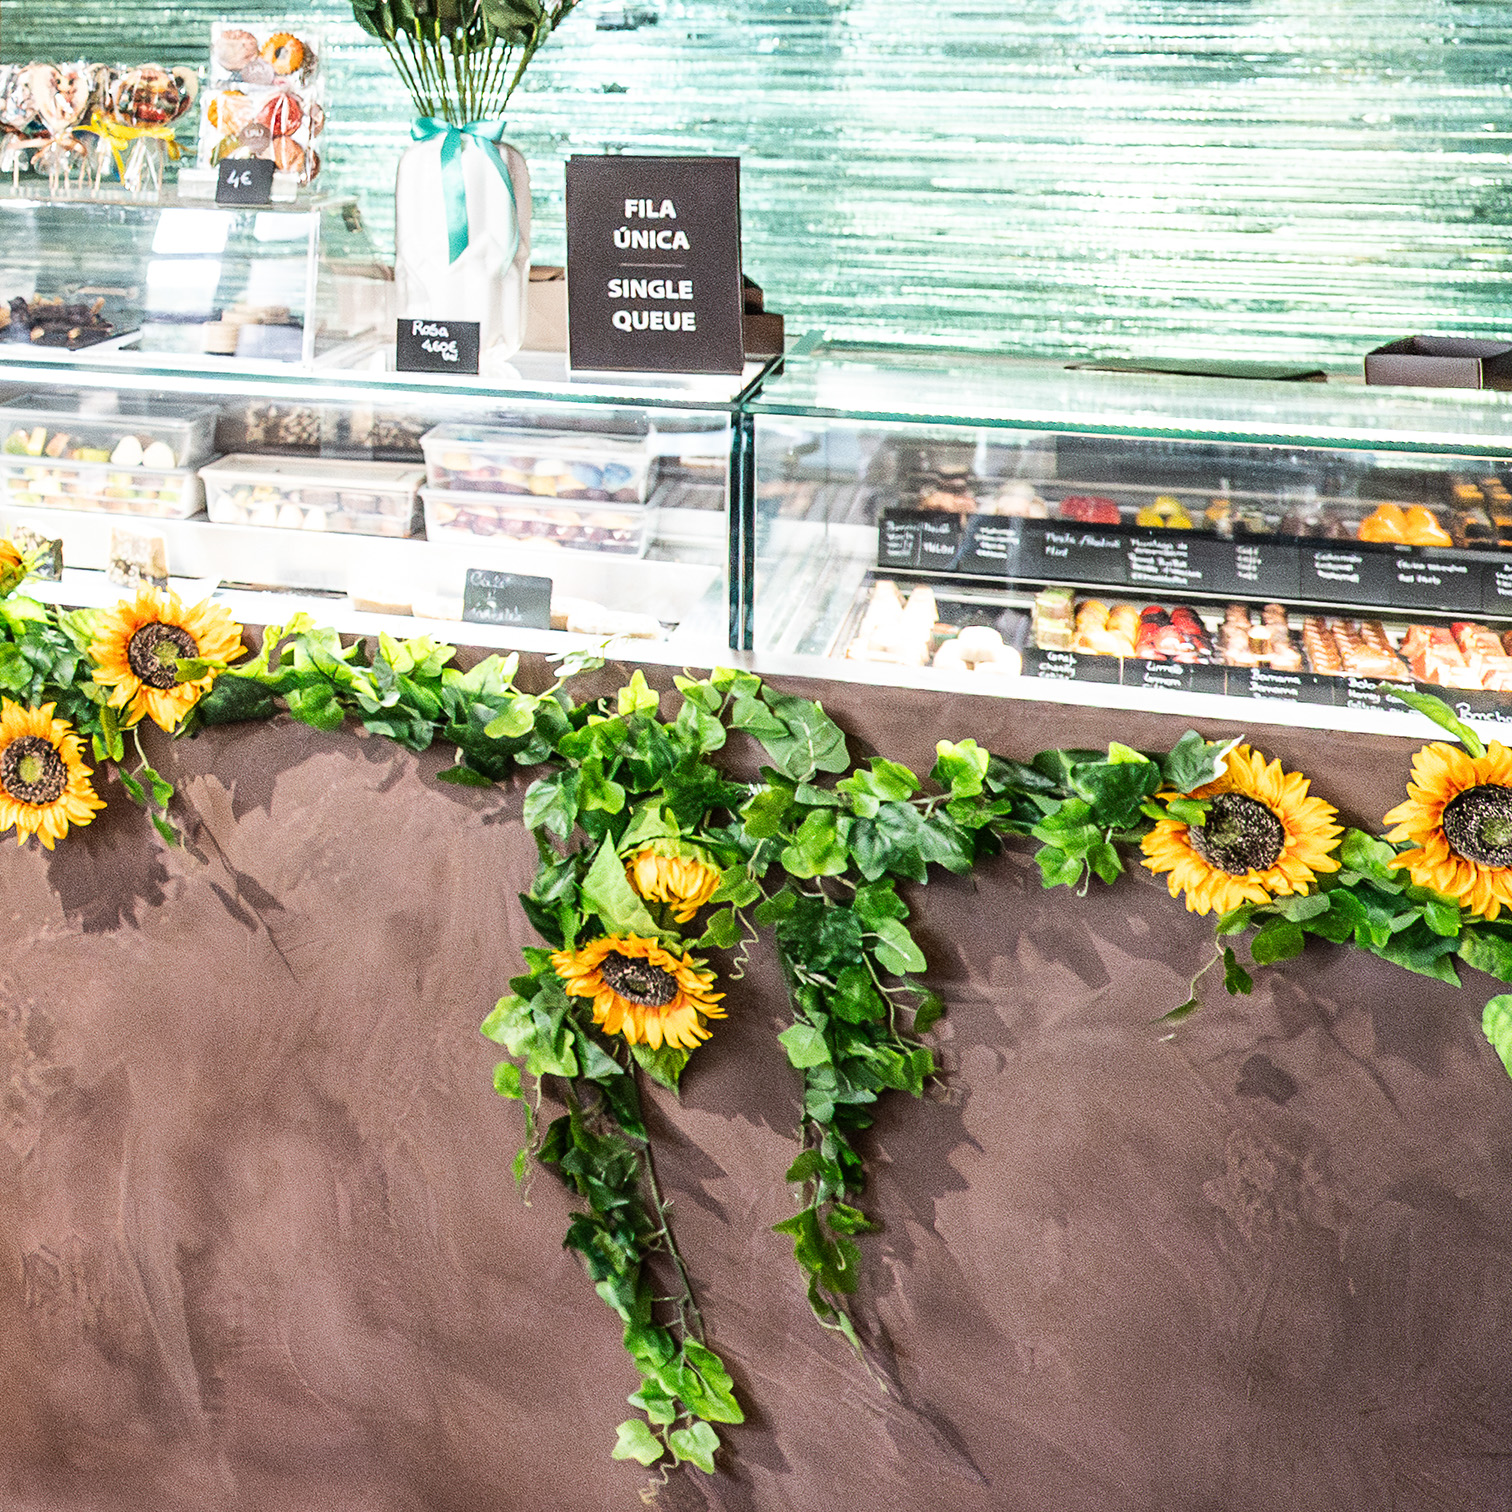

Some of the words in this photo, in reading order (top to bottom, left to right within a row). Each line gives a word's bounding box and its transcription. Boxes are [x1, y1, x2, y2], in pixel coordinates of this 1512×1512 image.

[228, 170, 253, 188] 4€
[624, 198, 677, 220] FILA
[612, 226, 691, 251] ÚNICA
[607, 278, 694, 301] SINGLE
[611, 310, 697, 333] QUEUE
